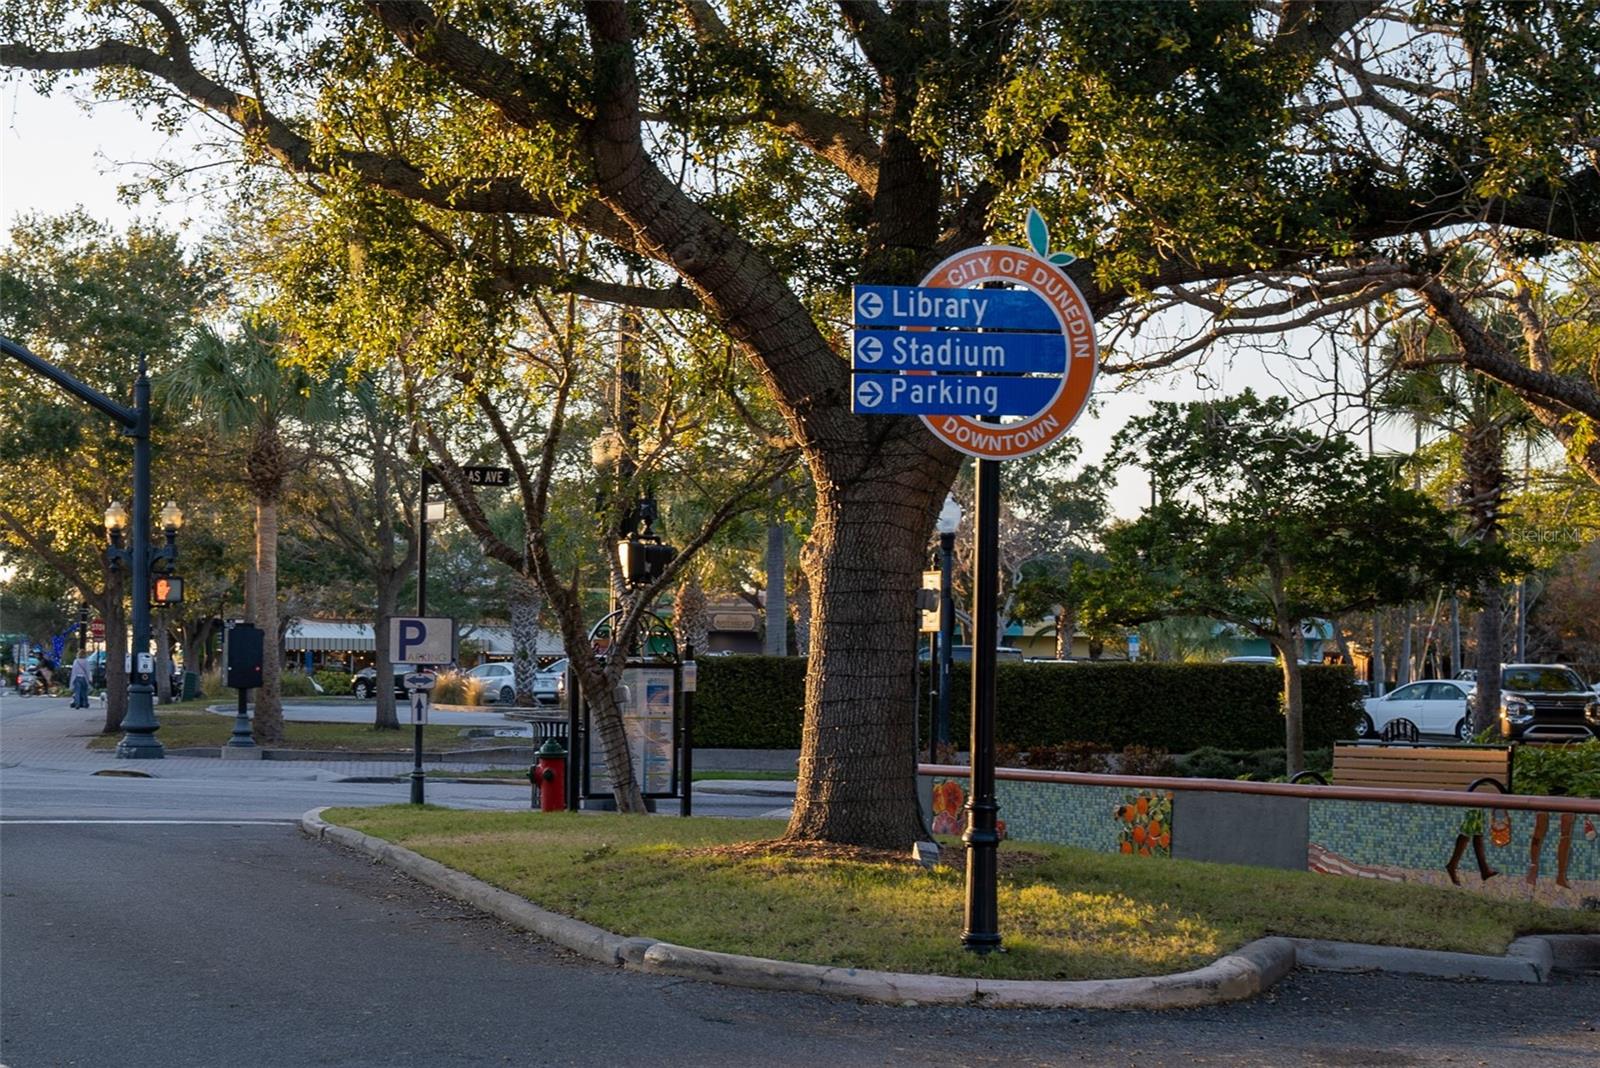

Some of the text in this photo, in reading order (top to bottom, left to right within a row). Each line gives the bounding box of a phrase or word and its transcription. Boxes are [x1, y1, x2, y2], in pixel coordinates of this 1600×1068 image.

[892, 289, 989, 326] Library
[947, 256, 1091, 358] CITY OF DUNEDIN
[891, 336, 1006, 367] Stadium
[891, 378, 999, 413] Parking
[942, 414, 1060, 451] DOWNTOWN
[484, 470, 505, 483] AVE
